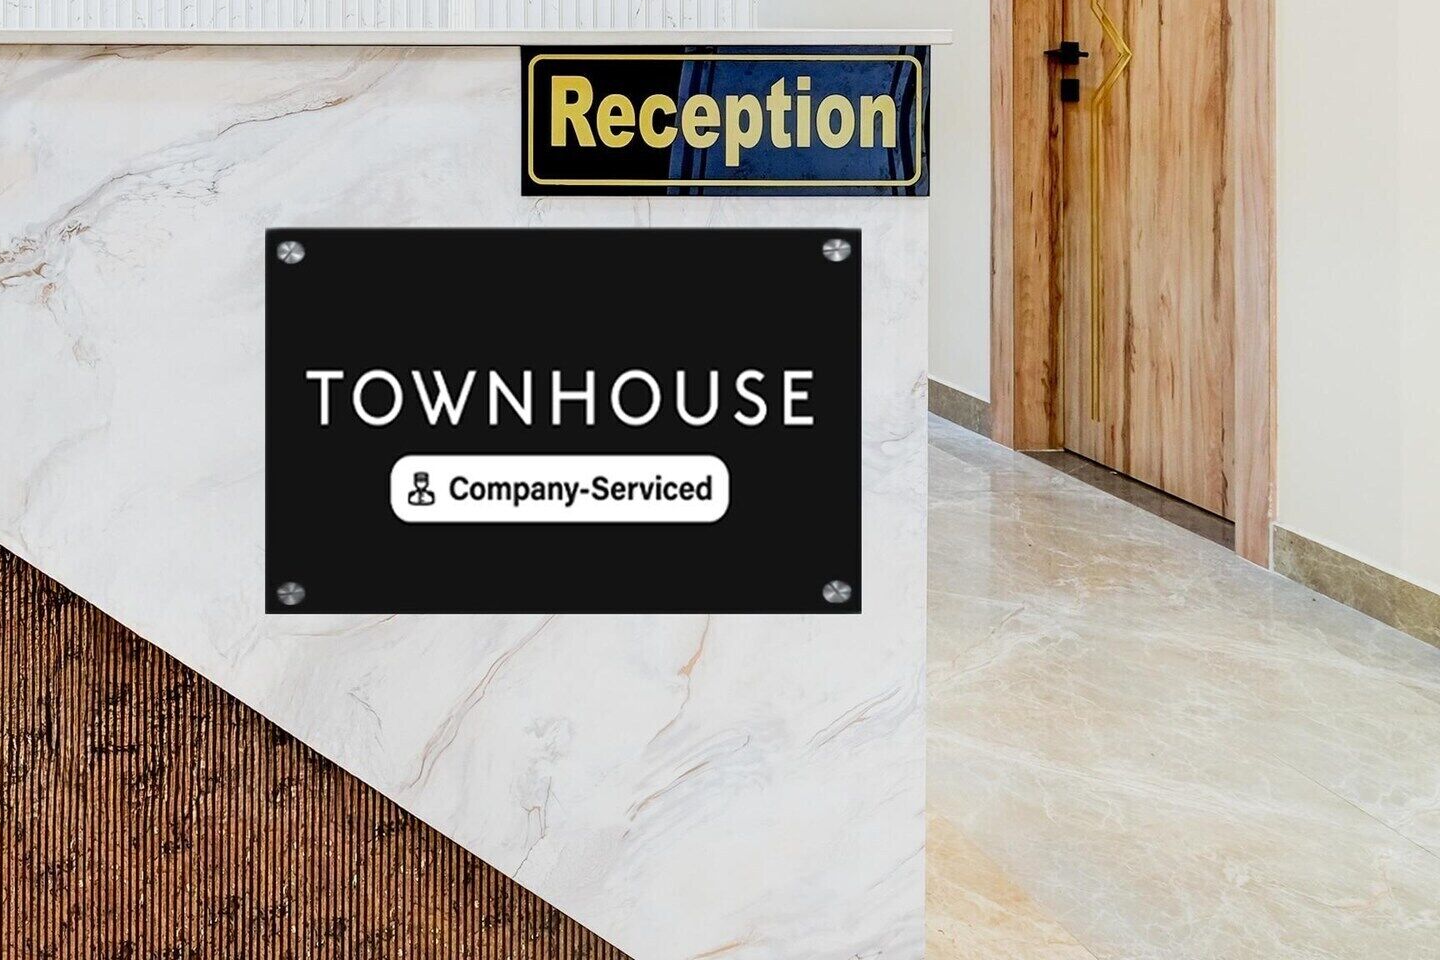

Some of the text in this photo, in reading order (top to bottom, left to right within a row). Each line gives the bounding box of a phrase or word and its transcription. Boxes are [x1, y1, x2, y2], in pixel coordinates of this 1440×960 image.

[550, 75, 896, 166] Reception
[306, 370, 814, 425] TOWNHOUSE
[449, 475, 712, 507] Company-Serviced
